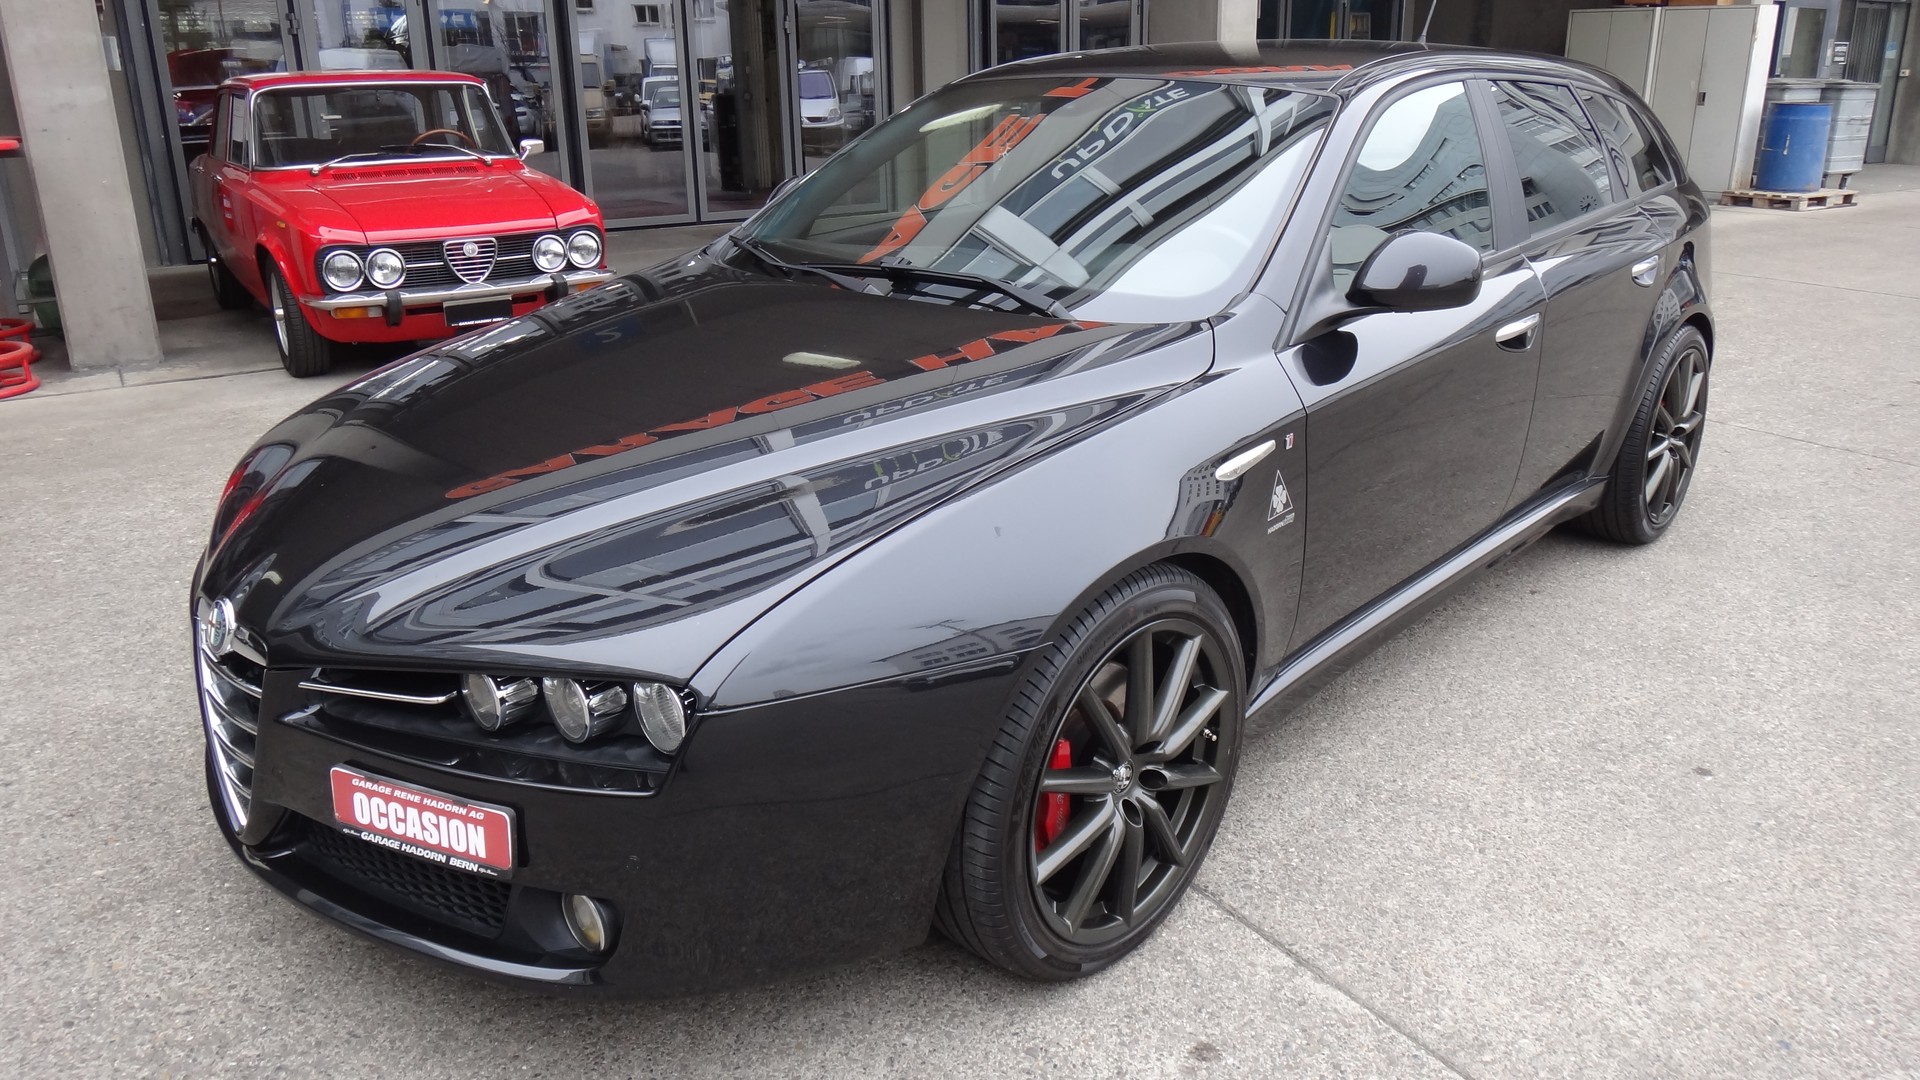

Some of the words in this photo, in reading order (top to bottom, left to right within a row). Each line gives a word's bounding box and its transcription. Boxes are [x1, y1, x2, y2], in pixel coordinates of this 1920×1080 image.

[352, 778, 392, 796] GARAGE
[393, 789, 421, 803] RENE
[422, 797, 467, 816] HADORN
[466, 809, 485, 820] AG
[352, 791, 487, 859] OCCASION
[360, 831, 401, 850] GARAGE
[401, 843, 447, 863] HADORN
[449, 857, 479, 873] BERN
